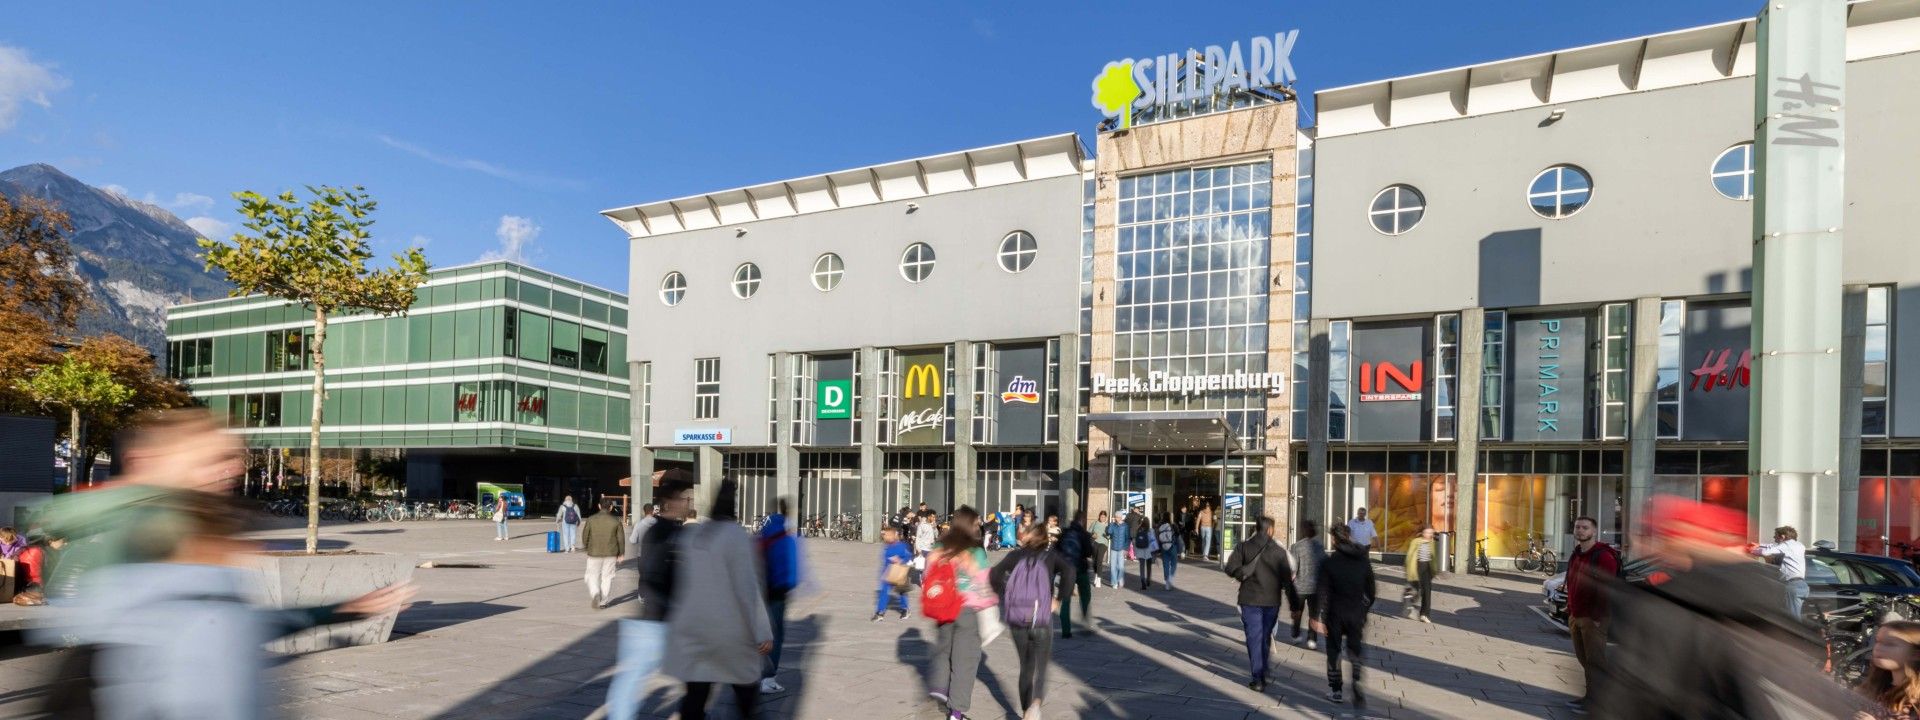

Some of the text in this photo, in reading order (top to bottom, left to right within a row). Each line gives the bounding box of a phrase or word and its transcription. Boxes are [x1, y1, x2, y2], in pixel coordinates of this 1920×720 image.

[1131, 29, 1299, 109] SILLPARK
[1771, 72, 1841, 147] H&M
[1009, 376, 1036, 393] dm
[1360, 360, 1423, 393] IN
[1538, 319, 1560, 432] PRIMARK
[825, 385, 844, 407] D
[682, 433, 716, 441] SPARKASSE
